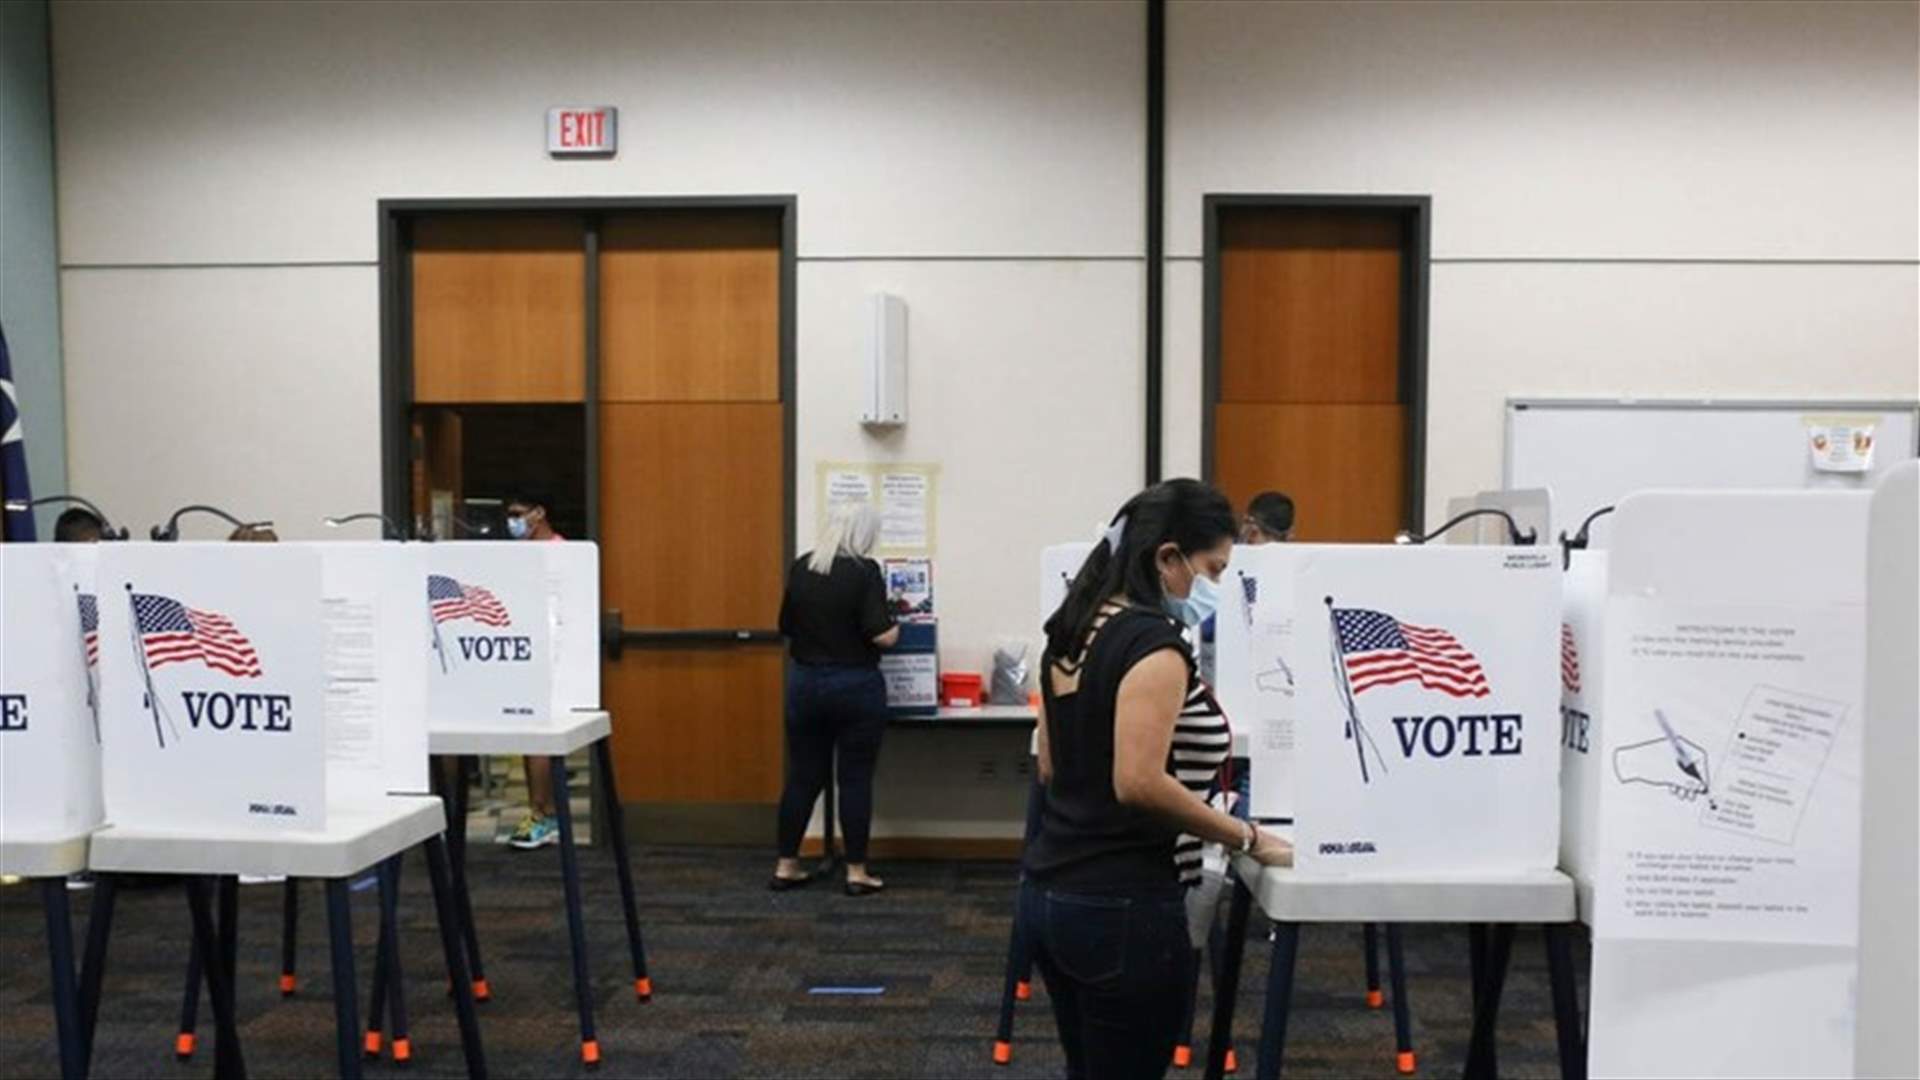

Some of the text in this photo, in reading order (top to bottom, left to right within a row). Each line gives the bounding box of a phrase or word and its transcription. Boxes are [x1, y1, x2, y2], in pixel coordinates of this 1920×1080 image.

[561, 112, 604, 147] EXIT
[457, 636, 532, 662] VOTE
[180, 690, 292, 733] VOTE
[1391, 713, 1523, 759] VOTE
